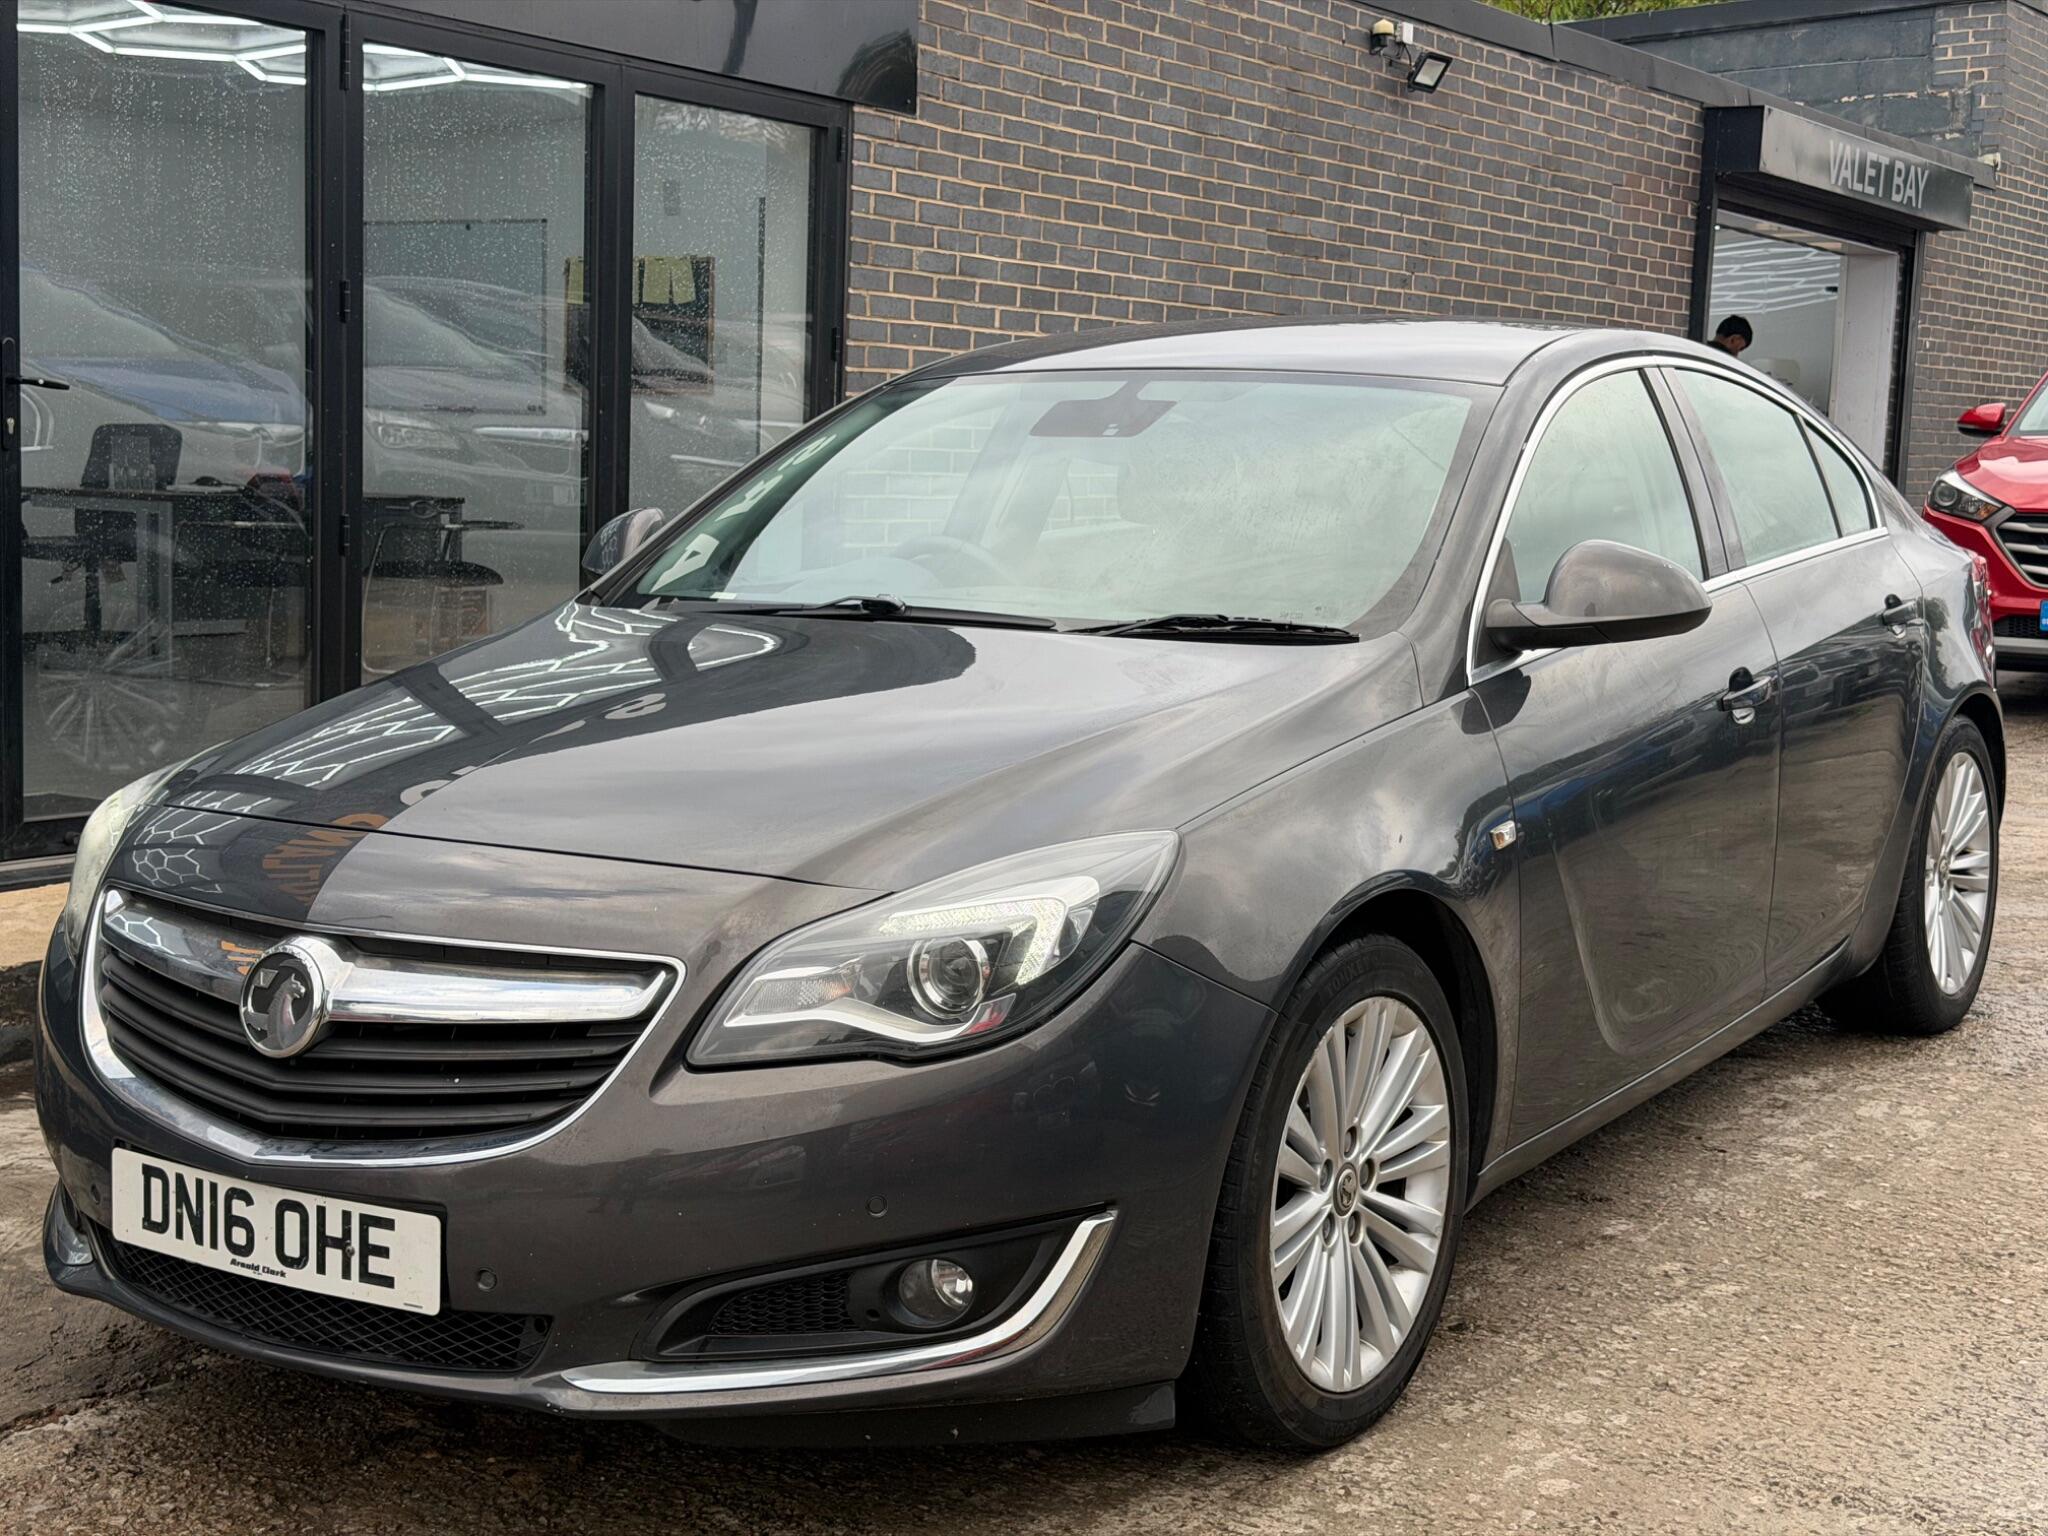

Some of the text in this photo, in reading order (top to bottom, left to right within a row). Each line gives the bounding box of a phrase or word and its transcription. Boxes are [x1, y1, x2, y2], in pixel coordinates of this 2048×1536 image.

[1830, 140, 1929, 209] VALET BAY
[141, 1163, 396, 1289] DN16 OHE
[230, 1258, 260, 1272] Arnold
[262, 1265, 286, 1278] Clark
